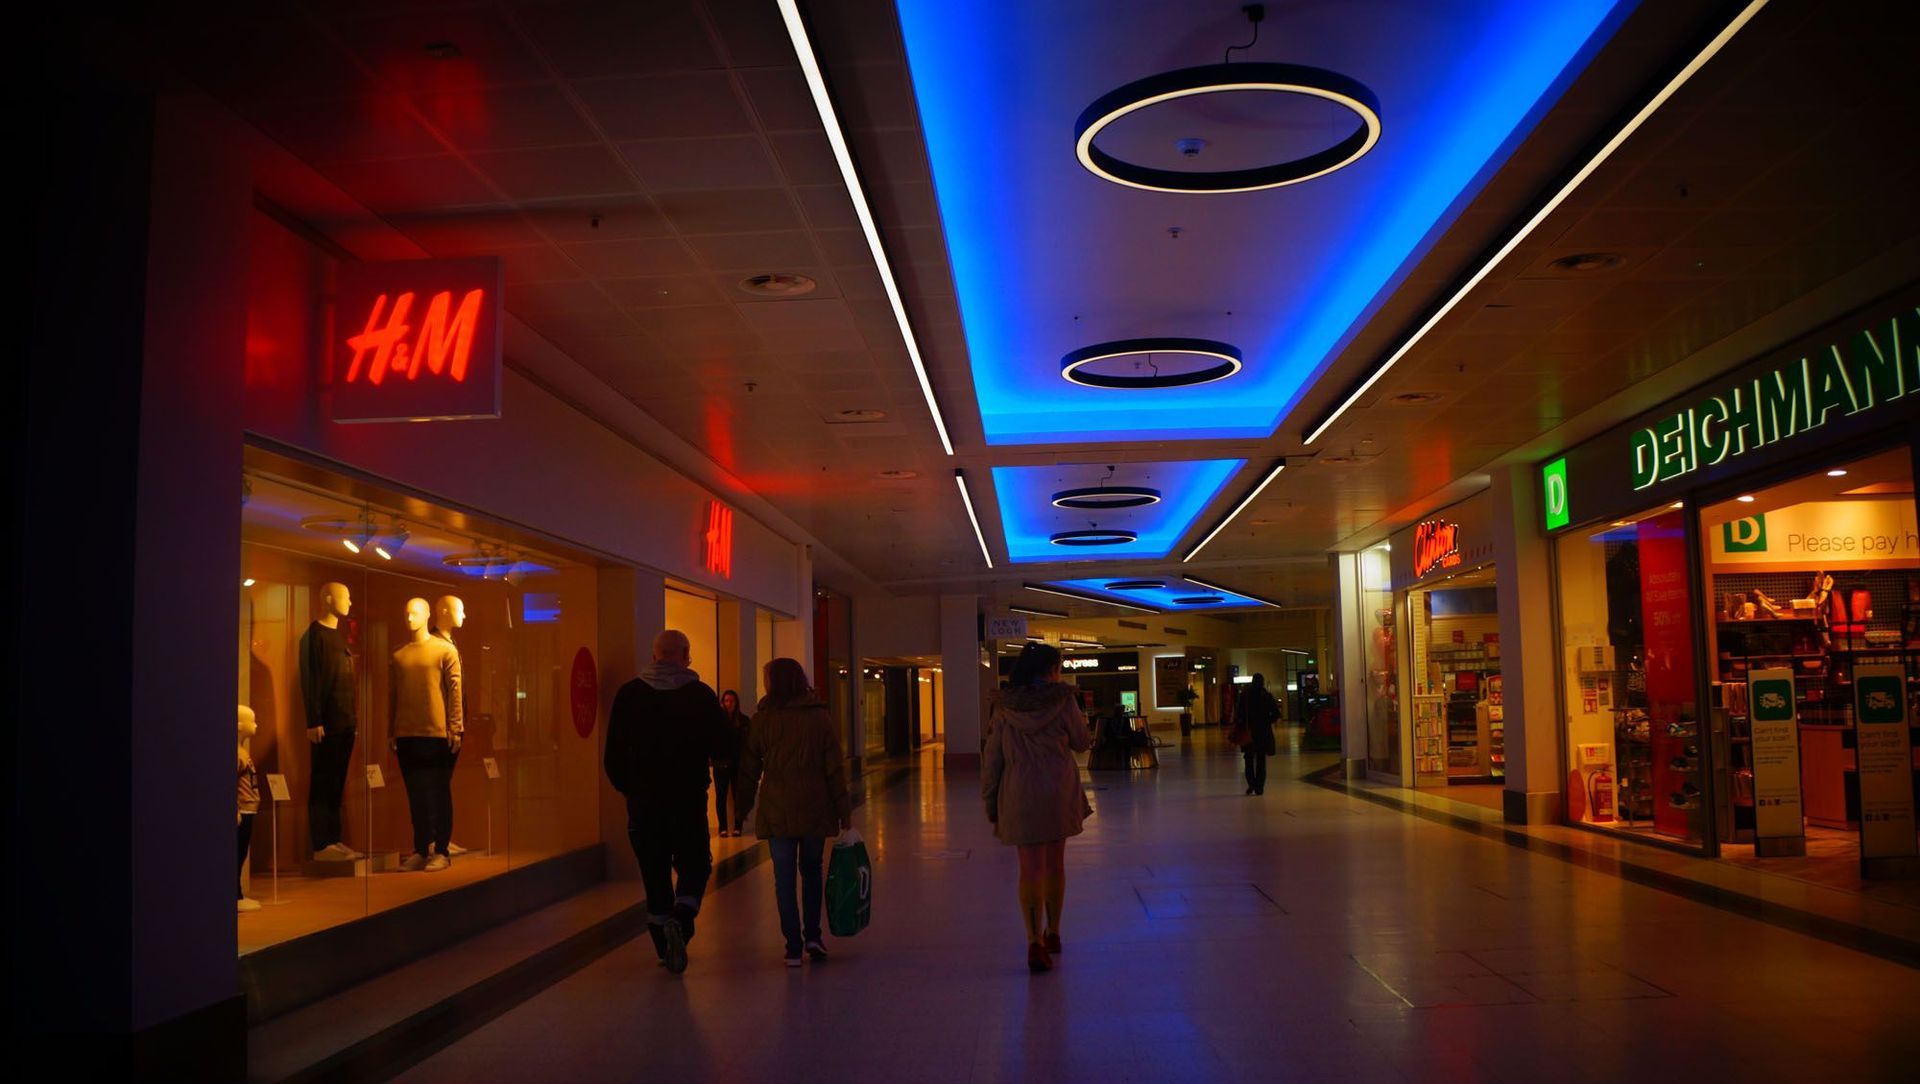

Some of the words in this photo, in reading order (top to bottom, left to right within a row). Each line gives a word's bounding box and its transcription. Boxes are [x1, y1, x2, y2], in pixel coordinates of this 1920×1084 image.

[345, 288, 484, 386] H&M
[1548, 473, 1565, 515] D
[1788, 533, 1855, 552] Please
[1862, 535, 1898, 554] pay
[992, 619, 1020, 627] NEW
[1062, 658, 1099, 670] express
